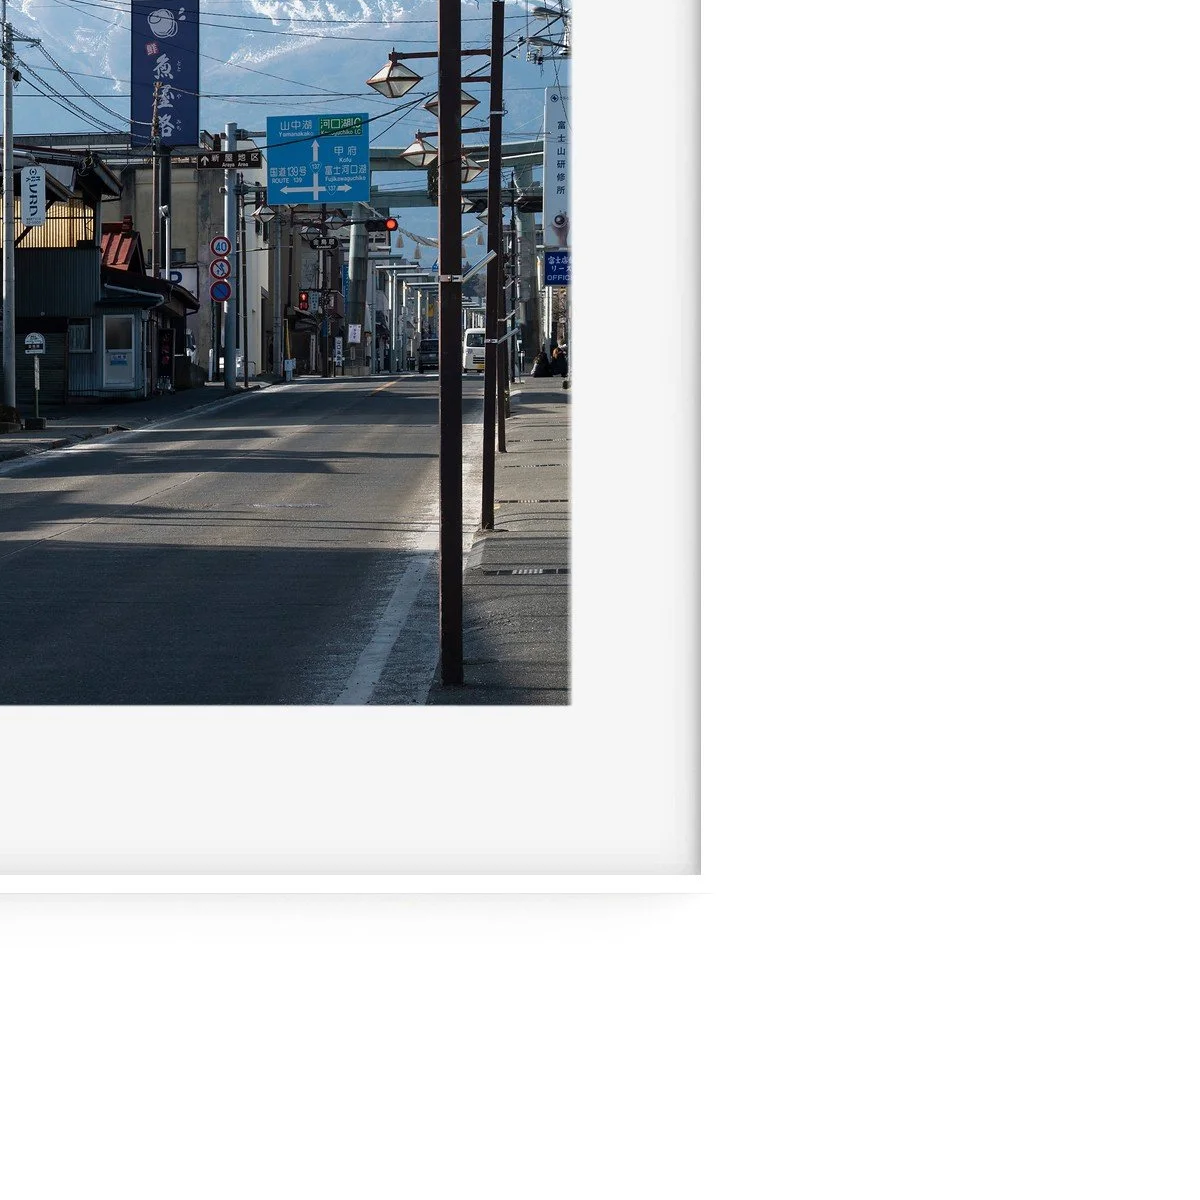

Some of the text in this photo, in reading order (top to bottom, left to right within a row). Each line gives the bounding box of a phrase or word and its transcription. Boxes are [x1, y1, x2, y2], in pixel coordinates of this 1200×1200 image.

[280, 120, 313, 131] 山中湖
[333, 145, 357, 156] 甲府
[211, 153, 259, 162] 新屋地区
[557, 120, 566, 194] 富士山研修所
[270, 166, 307, 177] 国道139号
[324, 164, 367, 176] 富士河口湖
[293, 176, 303, 184] 139
[215, 242, 227, 251] 40
